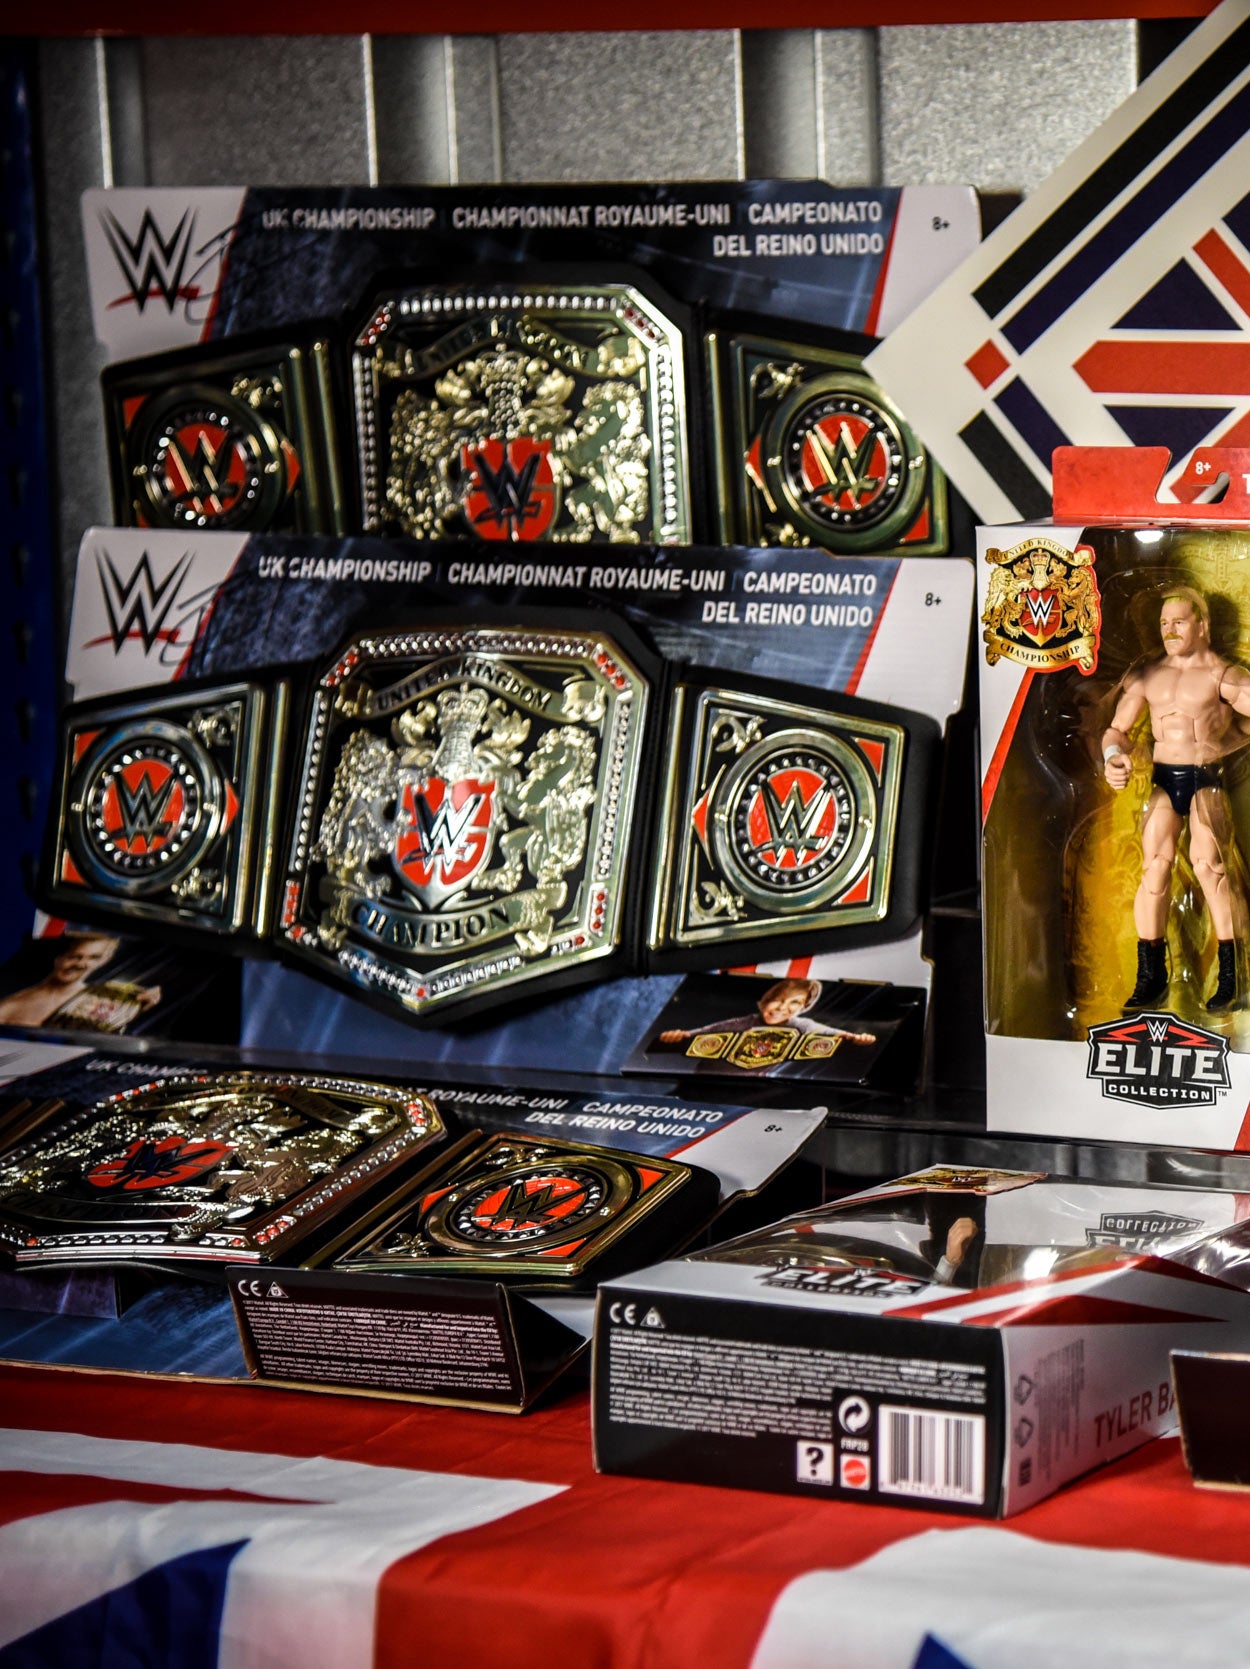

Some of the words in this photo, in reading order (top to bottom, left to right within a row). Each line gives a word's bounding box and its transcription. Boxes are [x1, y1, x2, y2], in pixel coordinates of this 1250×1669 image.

[262, 211, 294, 229] UK
[298, 207, 436, 230] CHAMPIONSHIP
[452, 205, 588, 229] CHAMPIONNAT
[594, 203, 730, 228] ROYAUME-UNI
[748, 201, 882, 226] CAMPEONATO
[931, 215, 951, 231] 8+
[713, 234, 751, 257] DEL
[755, 233, 816, 257] REINO
[820, 233, 884, 256] UNIDO
[1195, 460, 1212, 476] 8+
[258, 555, 285, 579] UK
[288, 556, 432, 583] CHAMPIONSHIP
[447, 560, 586, 588] CHAMPIONNAT
[588, 567, 727, 592] ROYAUME-UNI
[743, 571, 877, 597] CAMPEONATO
[924, 592, 942, 607] 8+
[702, 600, 739, 624] DEL
[744, 601, 804, 626] REINO
[809, 603, 873, 627] UNIDO
[1001, 644, 1080, 663] CHAMPIONSHIP
[1095, 1042, 1223, 1081] ELITE
[1108, 1084, 1211, 1100] COLLECTION
[582, 1100, 723, 1124] CAMPEONATO
[525, 1111, 565, 1125] DEL
[571, 1114, 634, 1132] REINO
[637, 1119, 706, 1139] UNIDO
[764, 1123, 784, 1135] 8+
[771, 1268, 927, 1294] ELITE
[1094, 1390, 1153, 1448] TYLER
